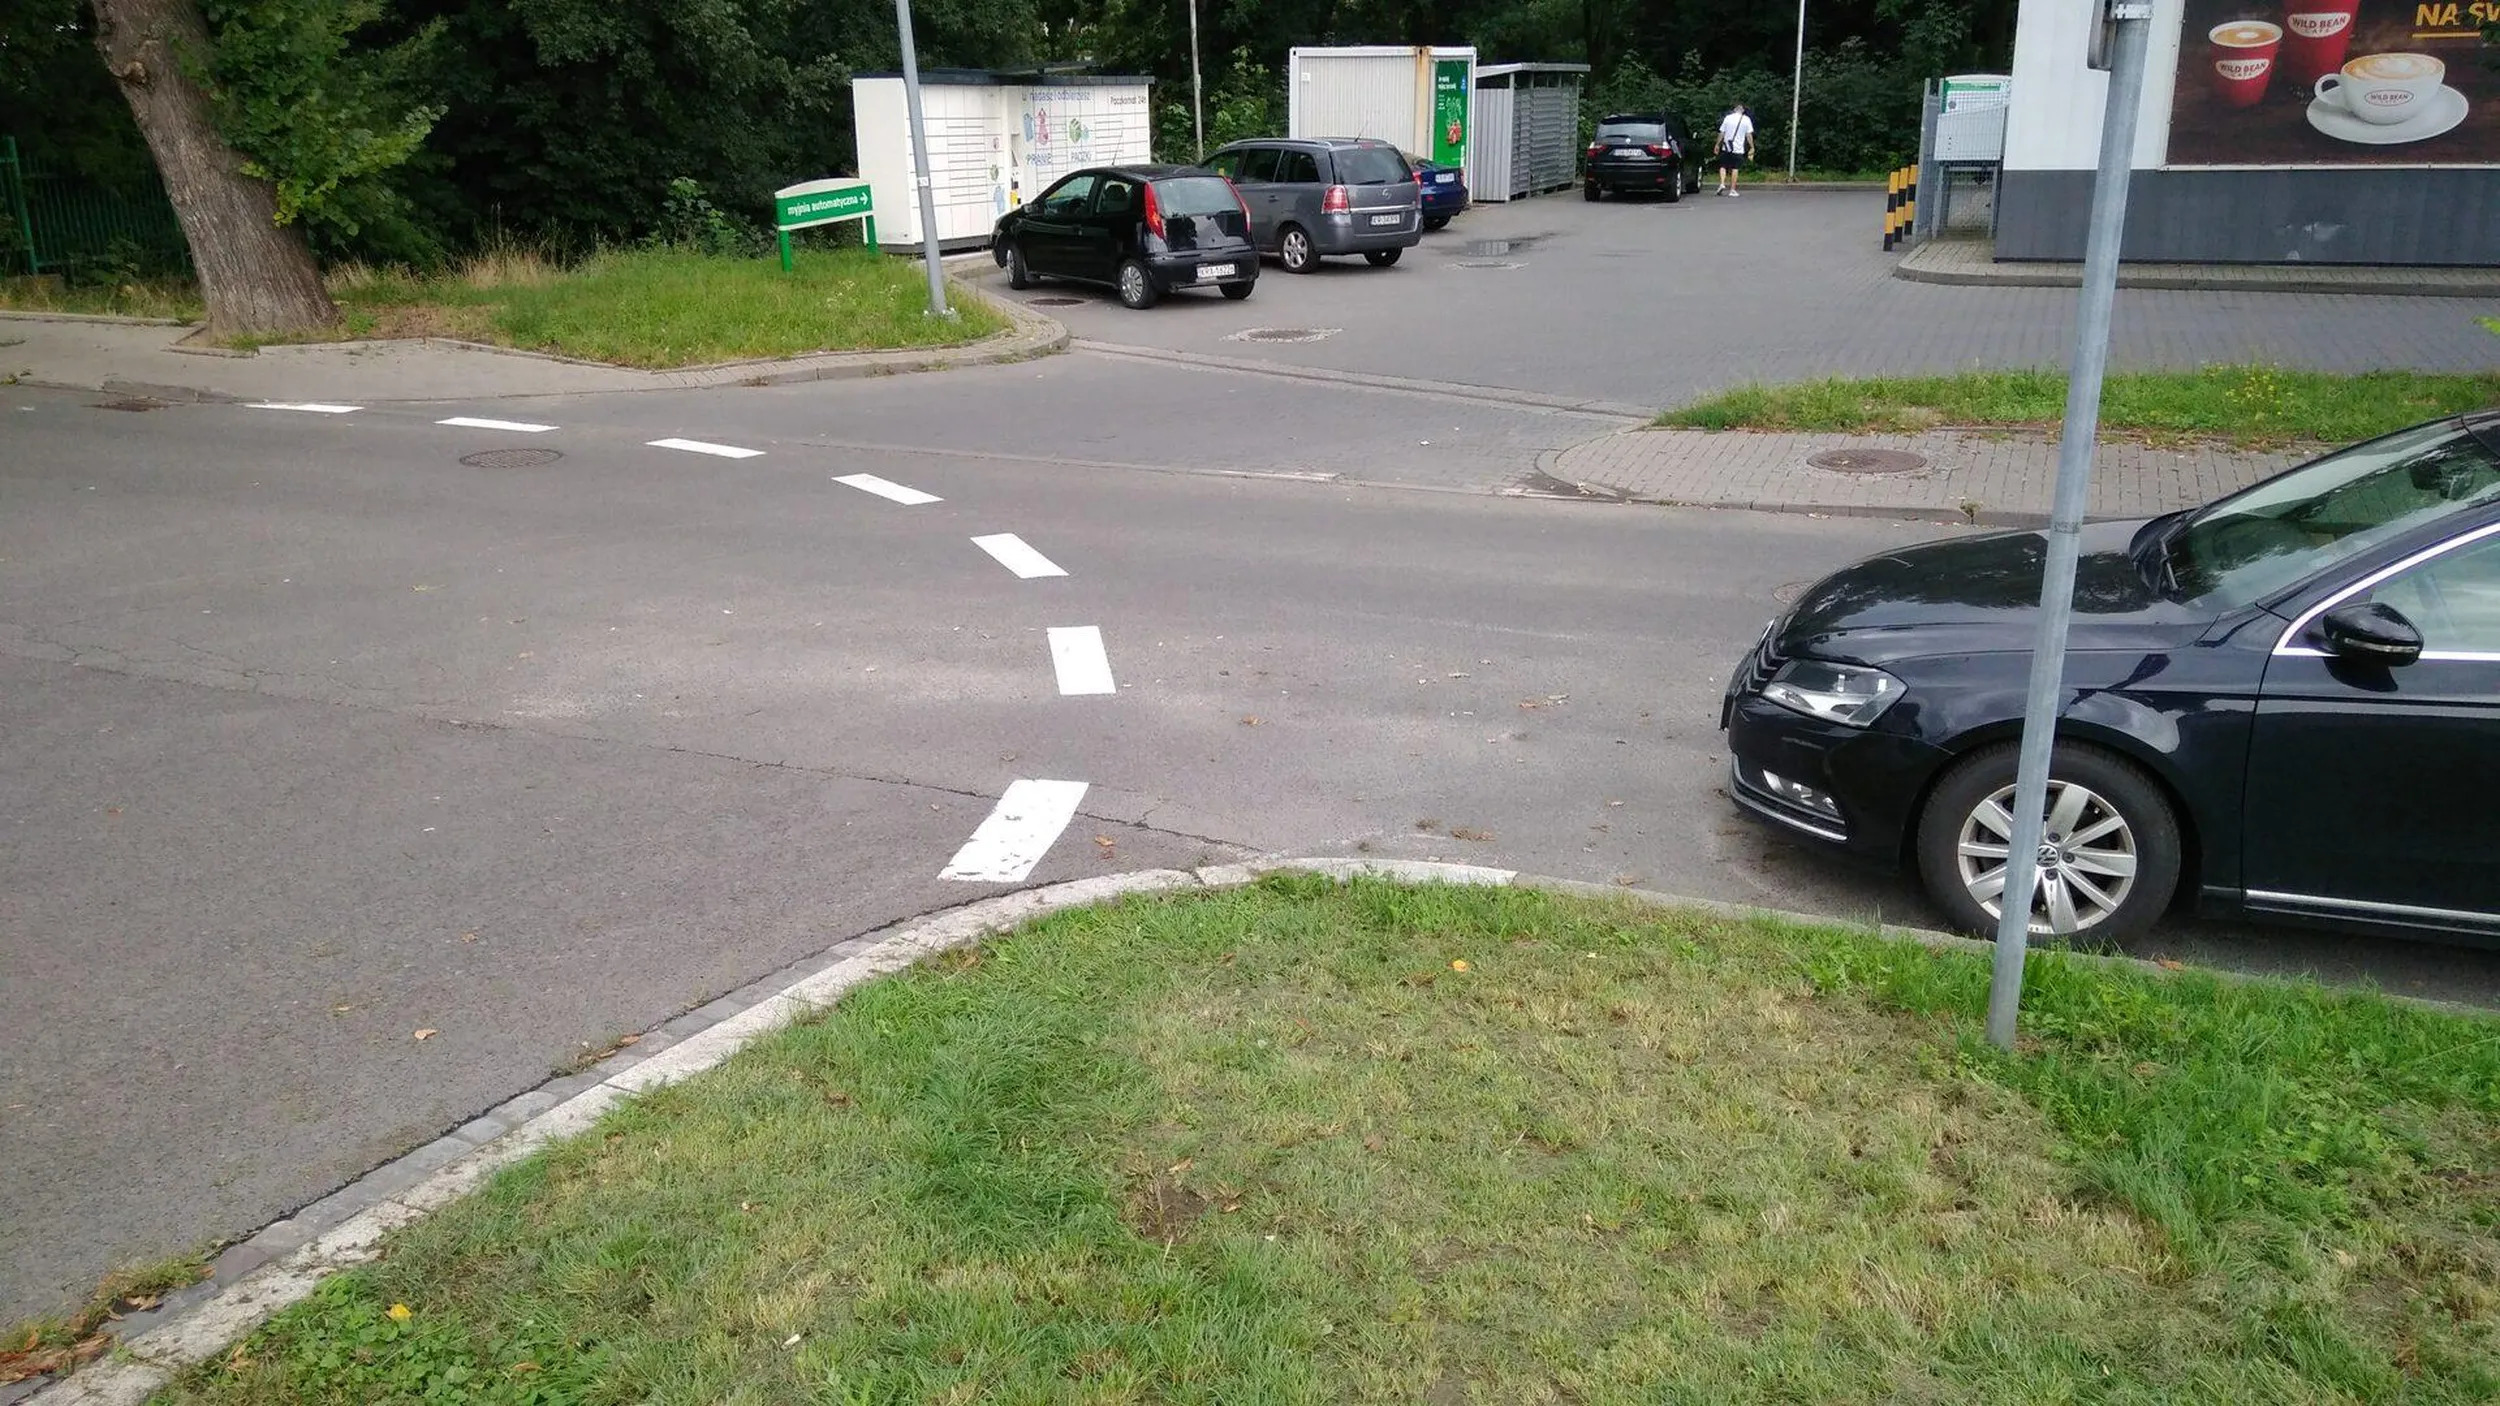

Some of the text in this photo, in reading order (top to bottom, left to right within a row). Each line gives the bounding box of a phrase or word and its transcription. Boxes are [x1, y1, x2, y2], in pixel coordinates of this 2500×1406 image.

[2291, 15, 2346, 29] WILD BEAN
[2415, 3, 2460, 26] NA
[2219, 61, 2267, 73] WILD BEAN
[787, 196, 858, 216] myjnia automatyczna
